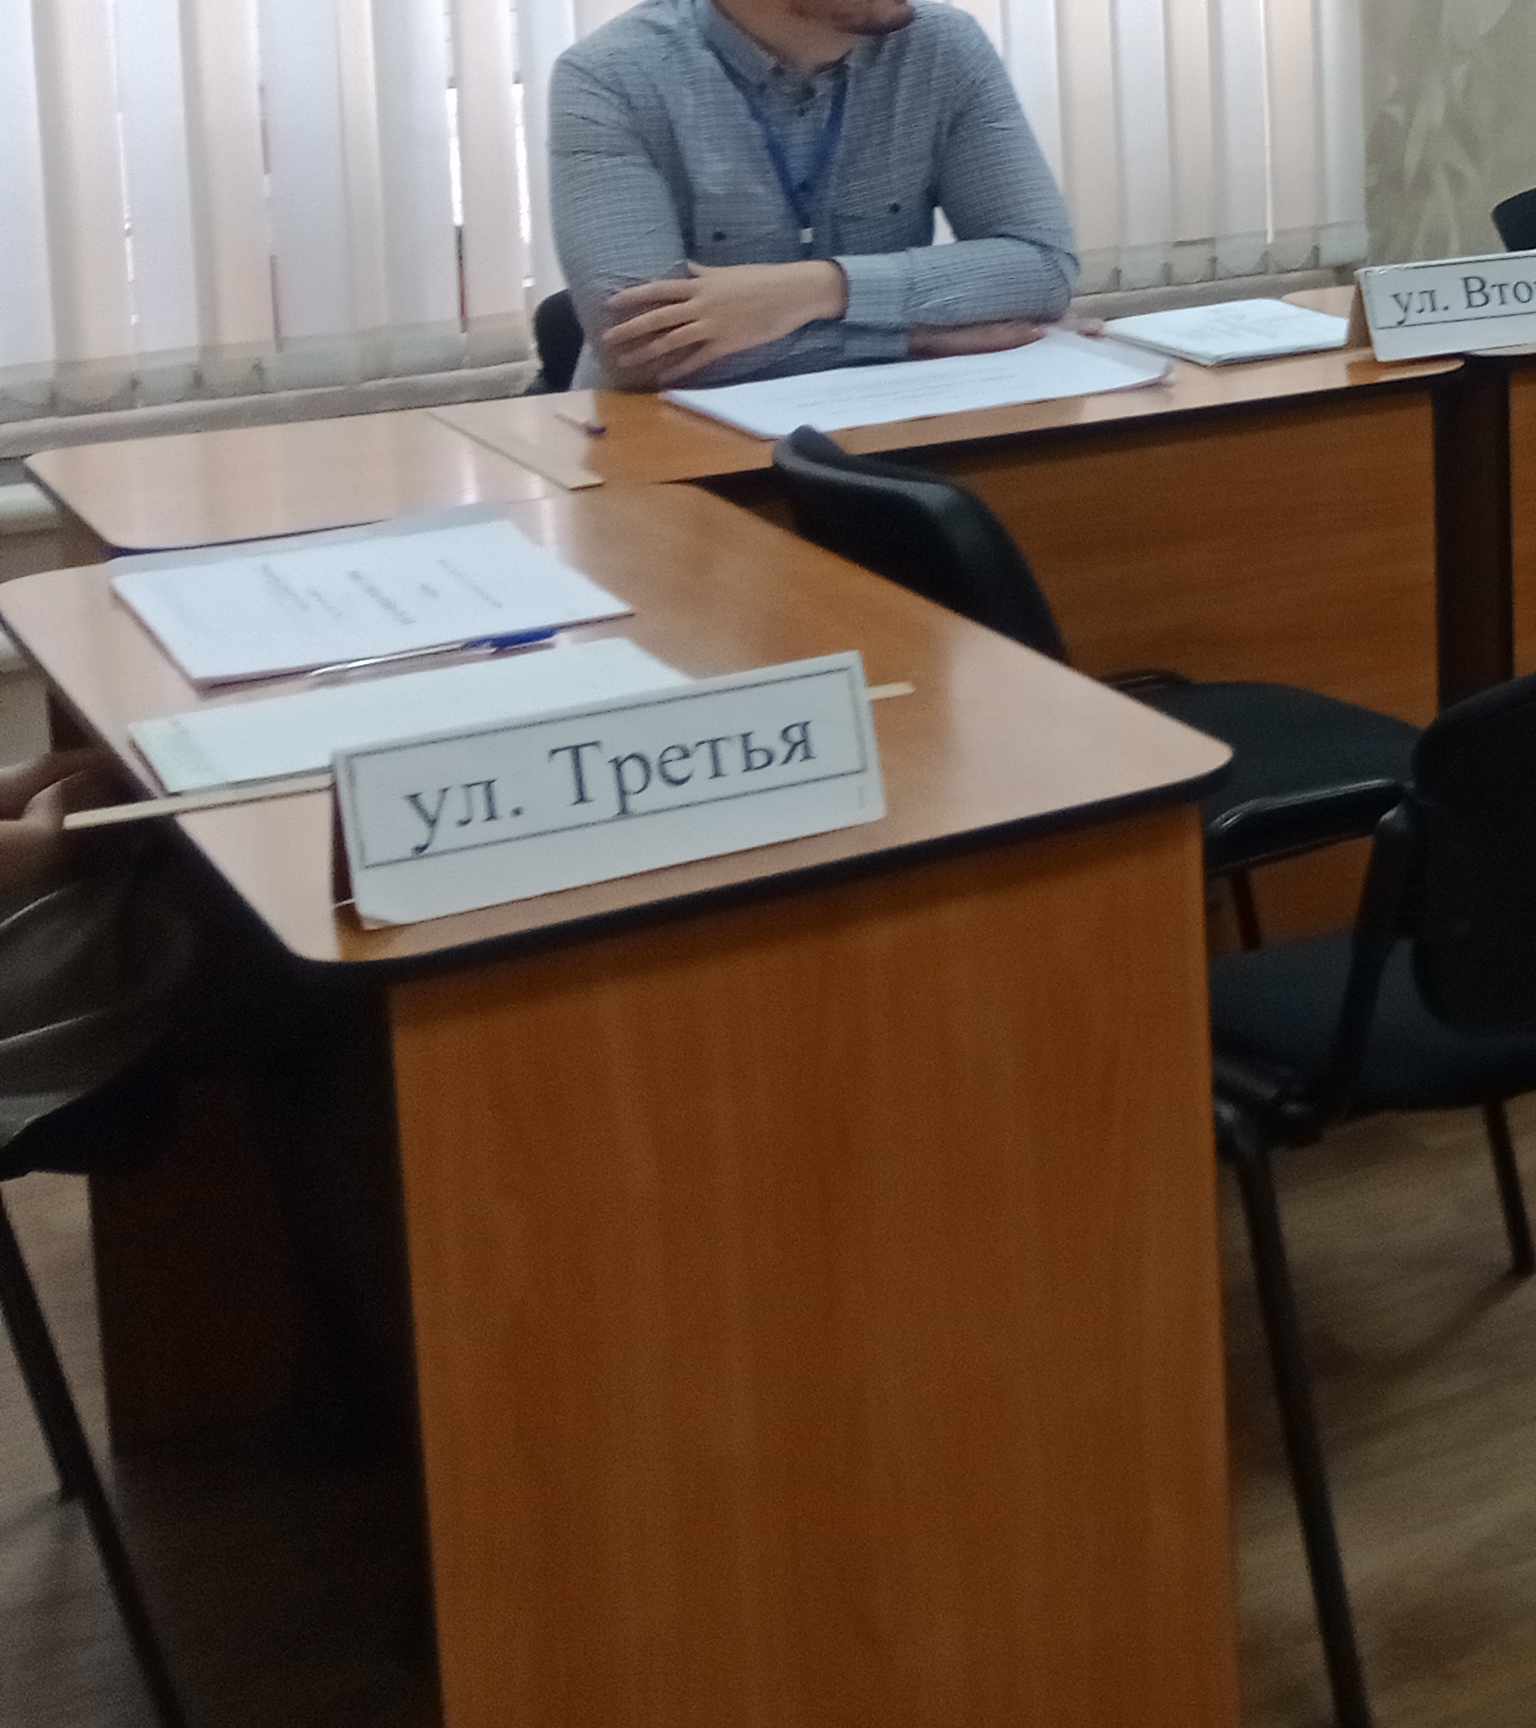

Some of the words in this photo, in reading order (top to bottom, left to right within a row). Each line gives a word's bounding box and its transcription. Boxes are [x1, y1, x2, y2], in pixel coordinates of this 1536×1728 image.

[1390, 283, 1449, 326] ул.
[404, 778, 525, 855] ул.
[548, 719, 817, 817] Третья
